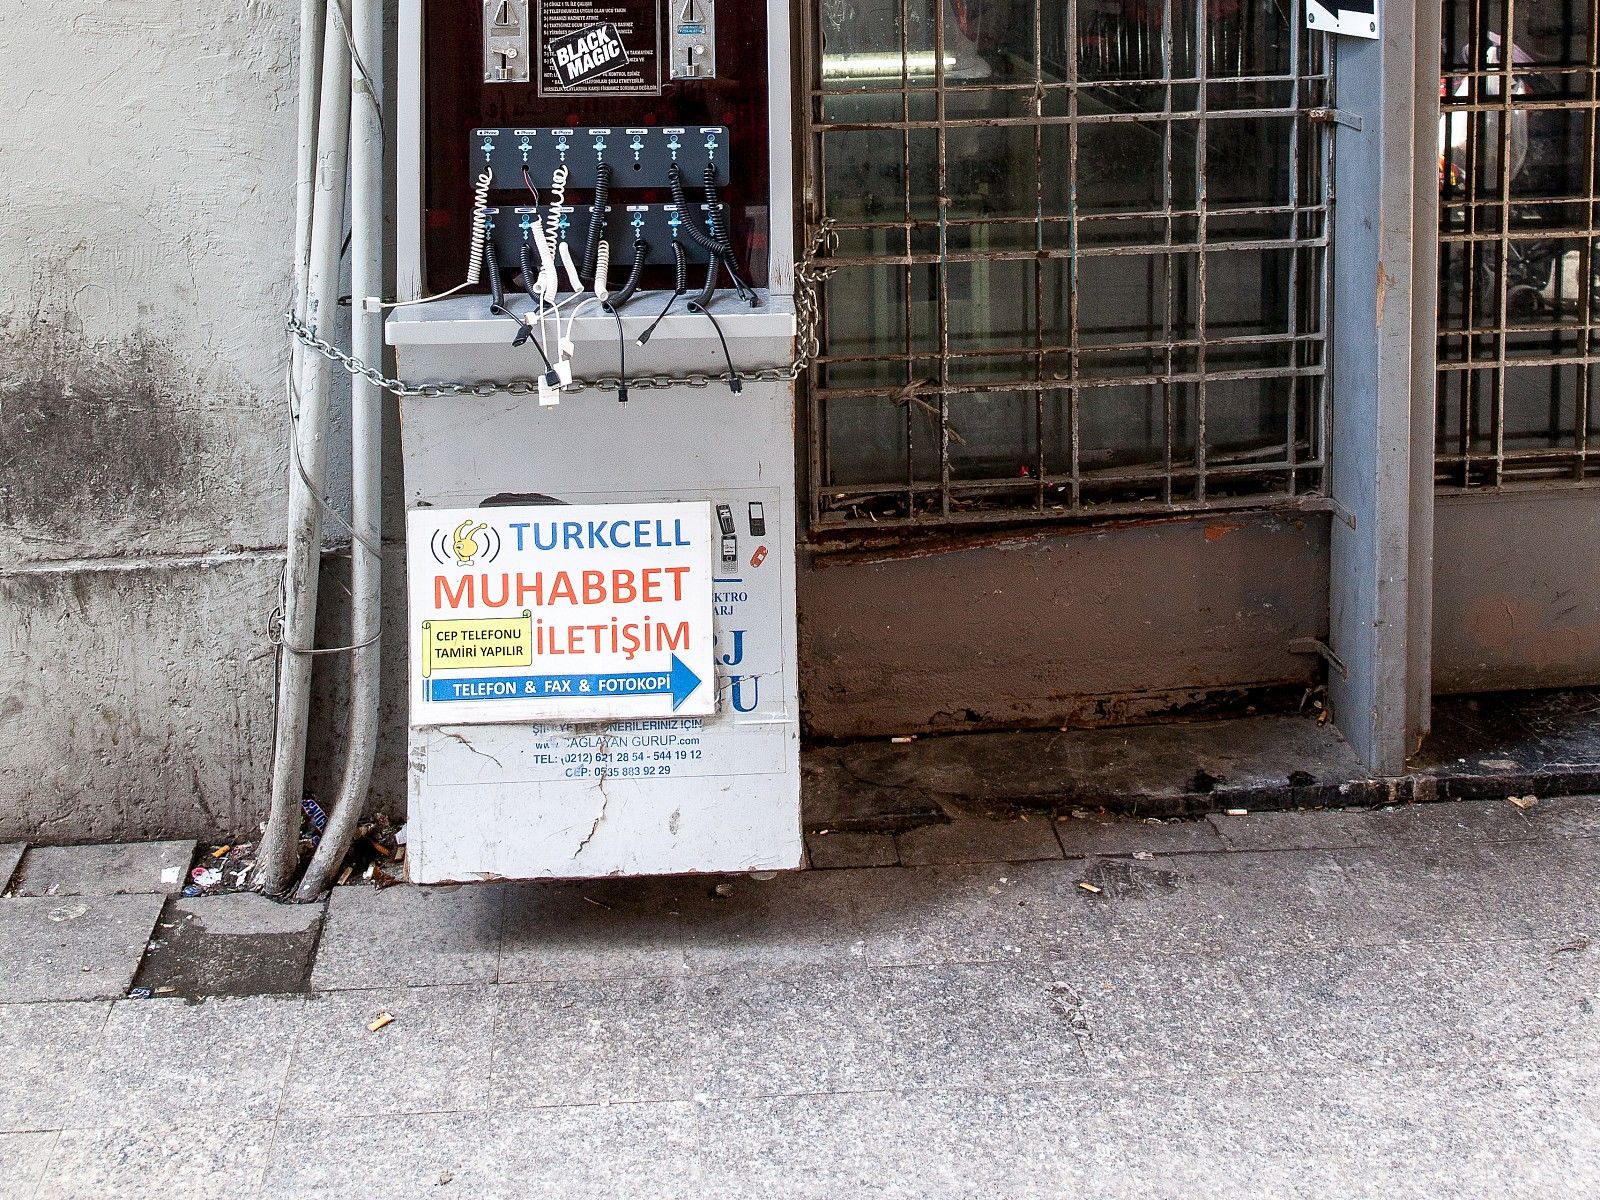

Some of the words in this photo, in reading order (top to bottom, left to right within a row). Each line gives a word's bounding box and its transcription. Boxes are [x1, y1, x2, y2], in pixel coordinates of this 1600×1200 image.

[555, 25, 612, 67] BLACK
[566, 39, 620, 81] MAGIC
[509, 518, 691, 551] TURKCELL
[433, 566, 690, 609] MUHABBET
[436, 630, 458, 641] CEP
[460, 628, 522, 641] TELEFONU
[536, 614, 690, 661] İLETİŞİM
[434, 644, 477, 659] TAMİRİ
[480, 645, 524, 657] YAPILIR
[452, 681, 517, 697] TELEFON
[524, 680, 537, 694] &
[543, 680, 572, 693] FAX
[578, 679, 591, 692] &
[599, 673, 672, 692] FOTOKOPİ
[533, 754, 558, 765] TEL:
[616, 752, 629, 763] 28
[631, 751, 644, 762] 54
[653, 750, 672, 761] 544
[675, 750, 687, 760] 19
[690, 749, 702, 760] 12
[643, 765, 656, 776] 92
[658, 764, 671, 775] 29
